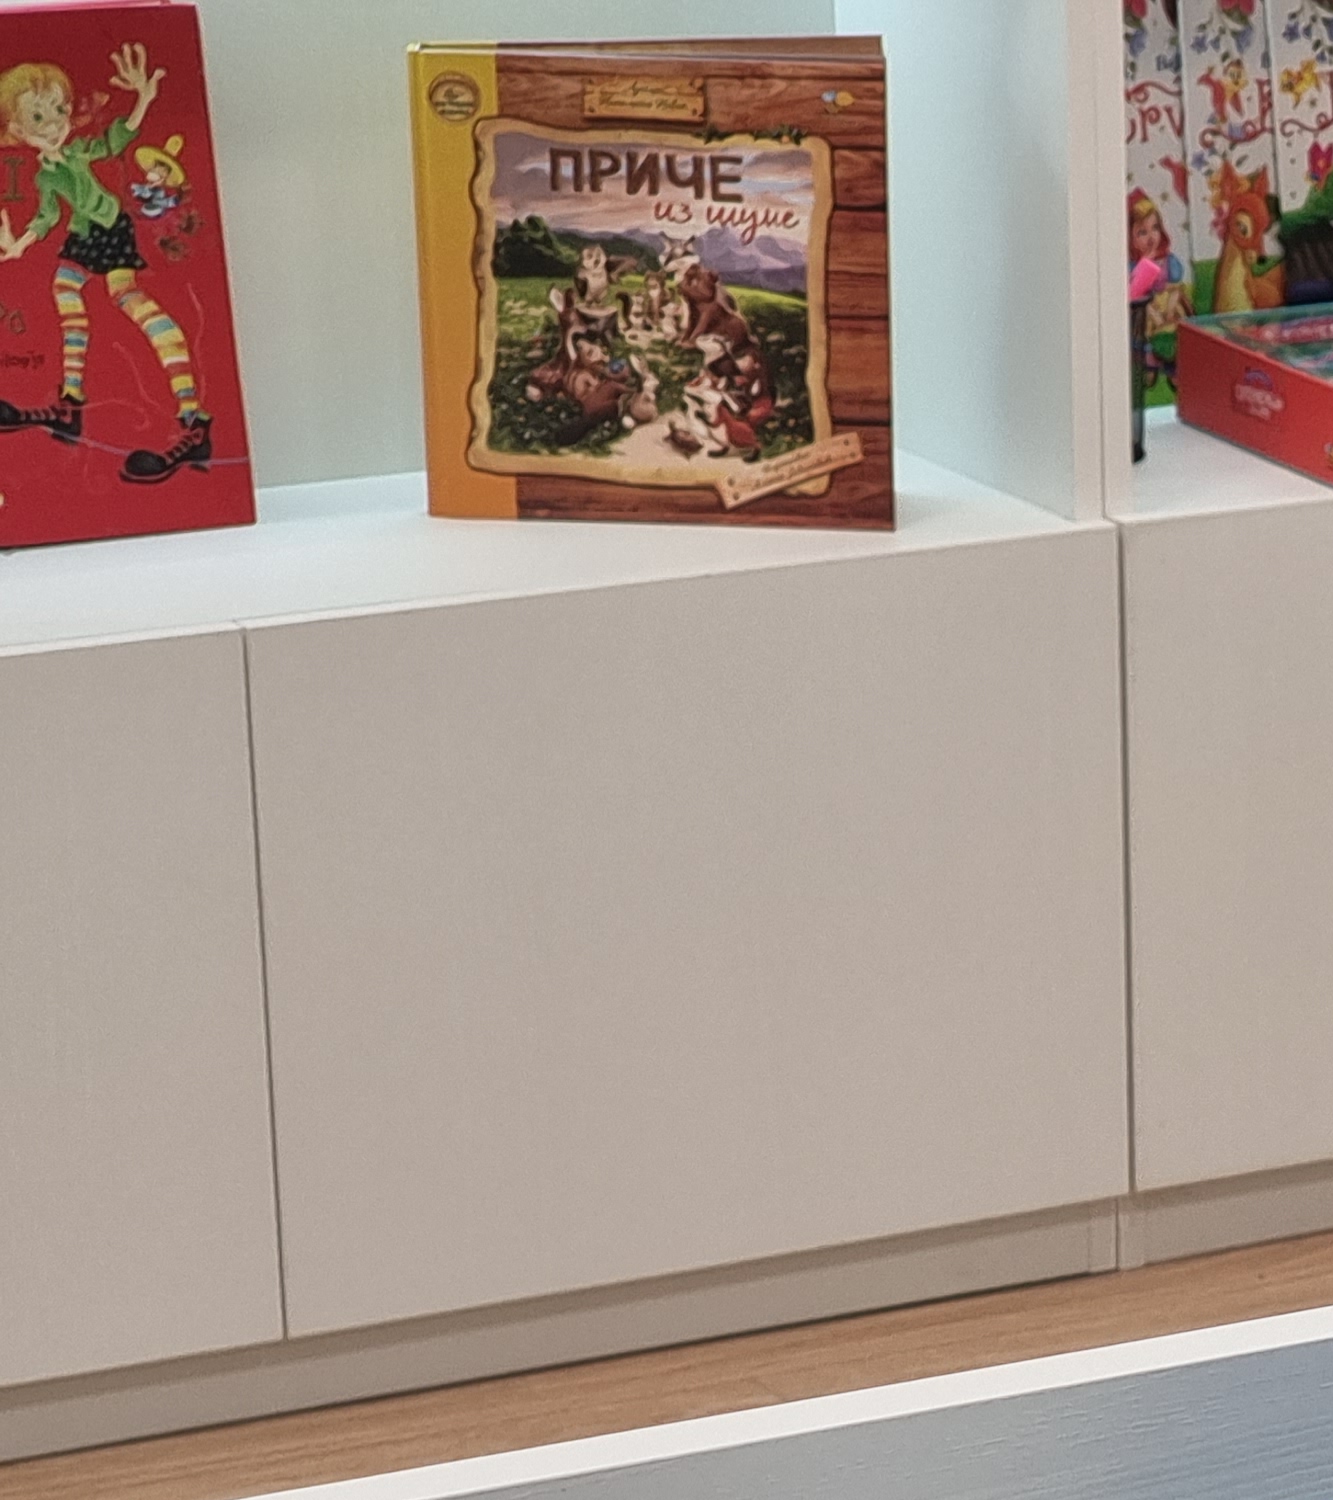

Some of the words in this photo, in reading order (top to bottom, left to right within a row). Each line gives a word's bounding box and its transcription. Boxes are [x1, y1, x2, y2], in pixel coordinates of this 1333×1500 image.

[549, 147, 744, 203] ПРИЧЕ
[654, 202, 693, 225] из
[706, 207, 802, 241] шуме
